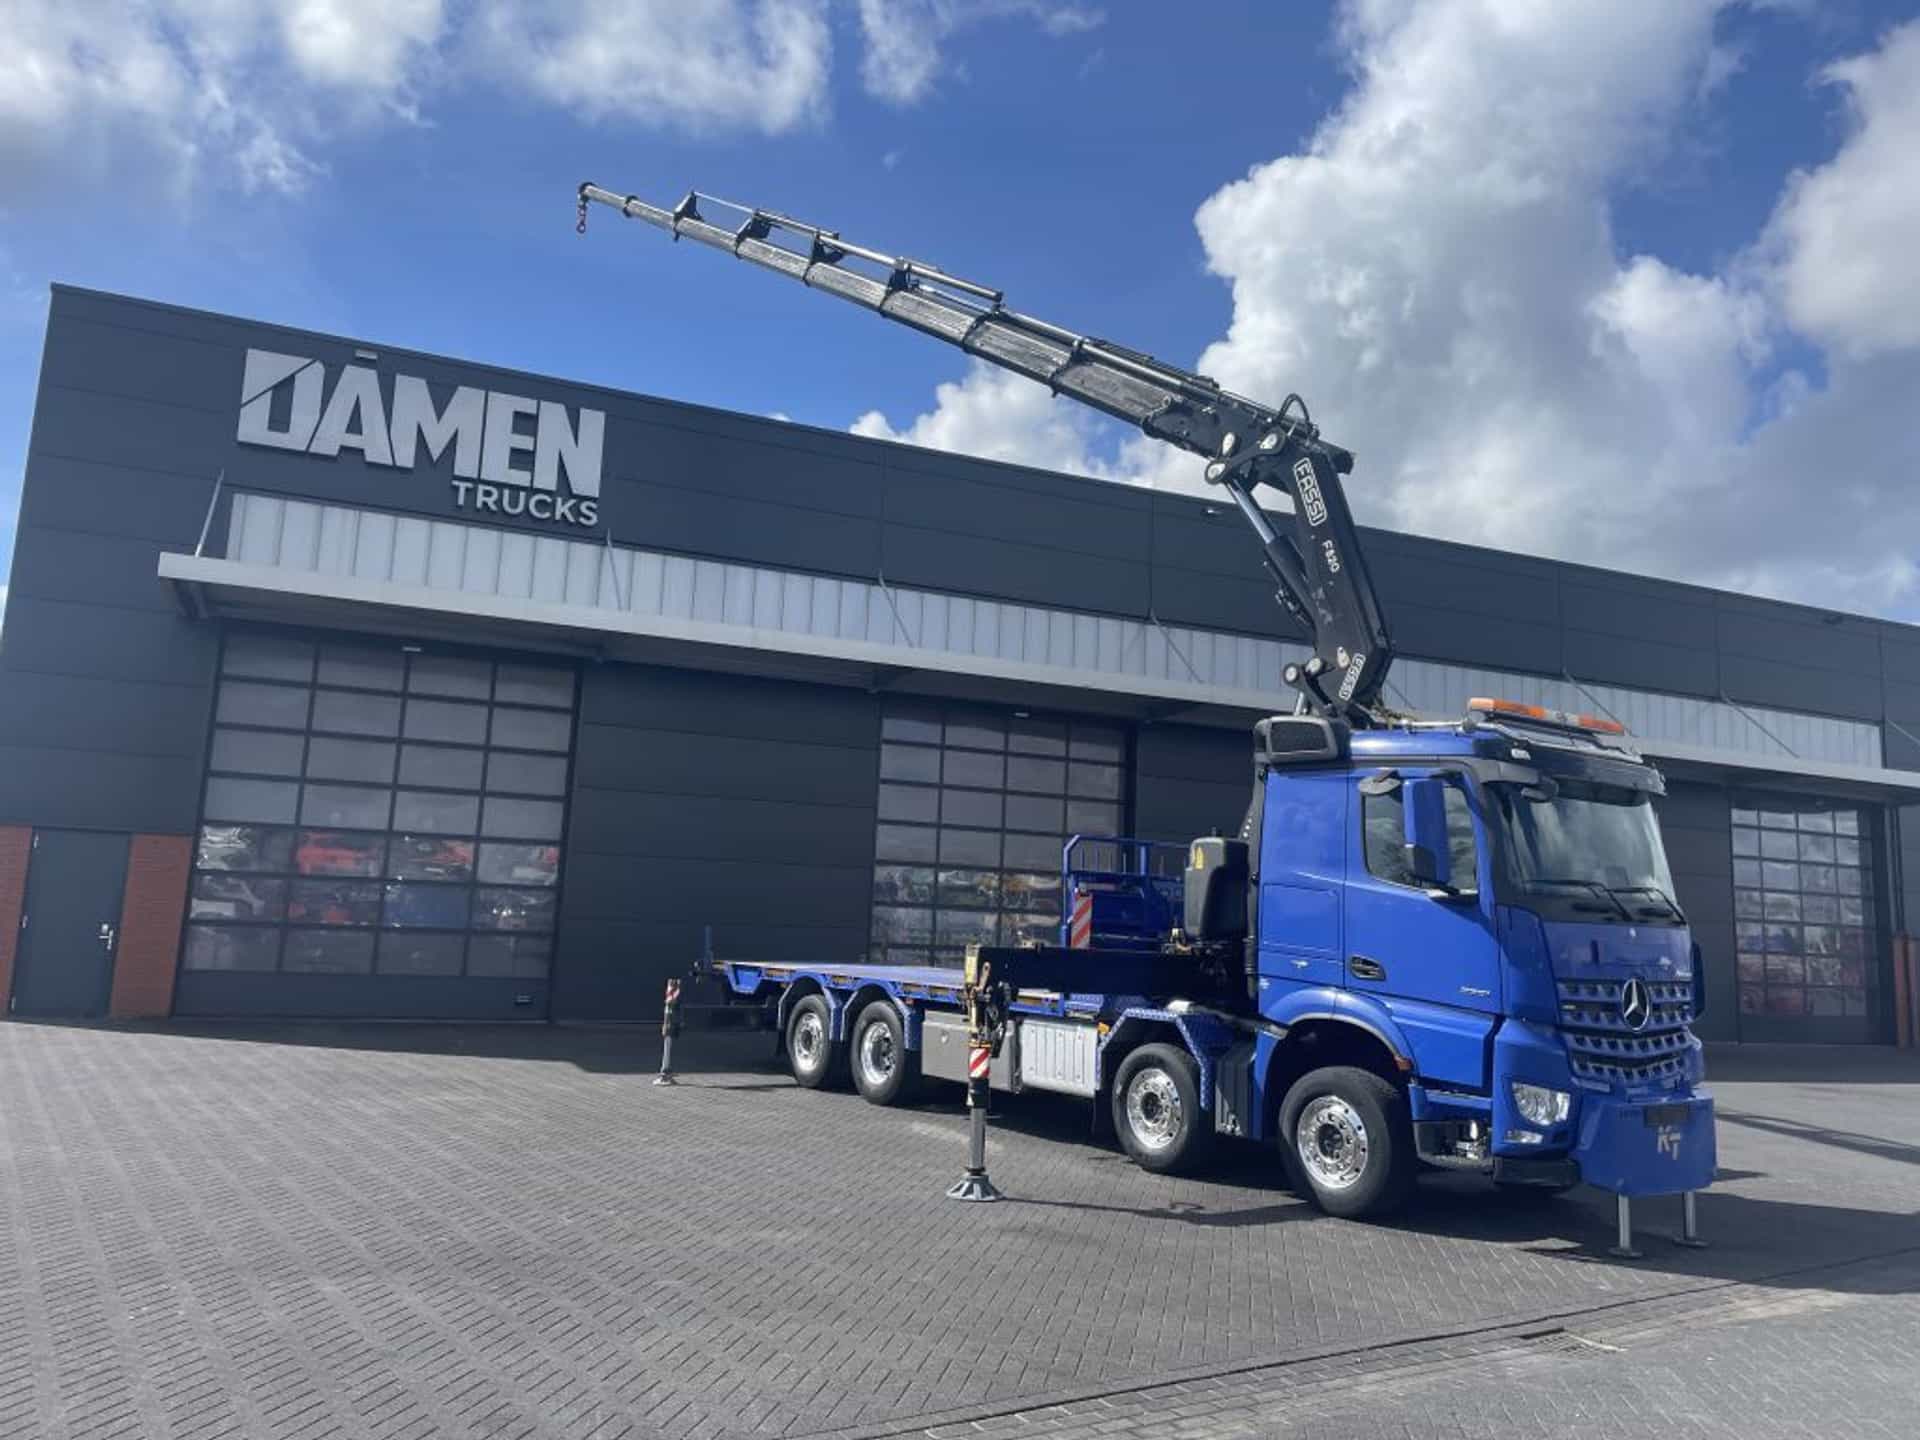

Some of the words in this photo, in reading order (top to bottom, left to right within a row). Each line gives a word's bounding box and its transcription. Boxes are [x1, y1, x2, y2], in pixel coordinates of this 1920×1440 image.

[237, 349, 605, 498] DAMEN
[452, 480, 599, 526] TRUCKS
[1295, 460, 1326, 524] FASSI
